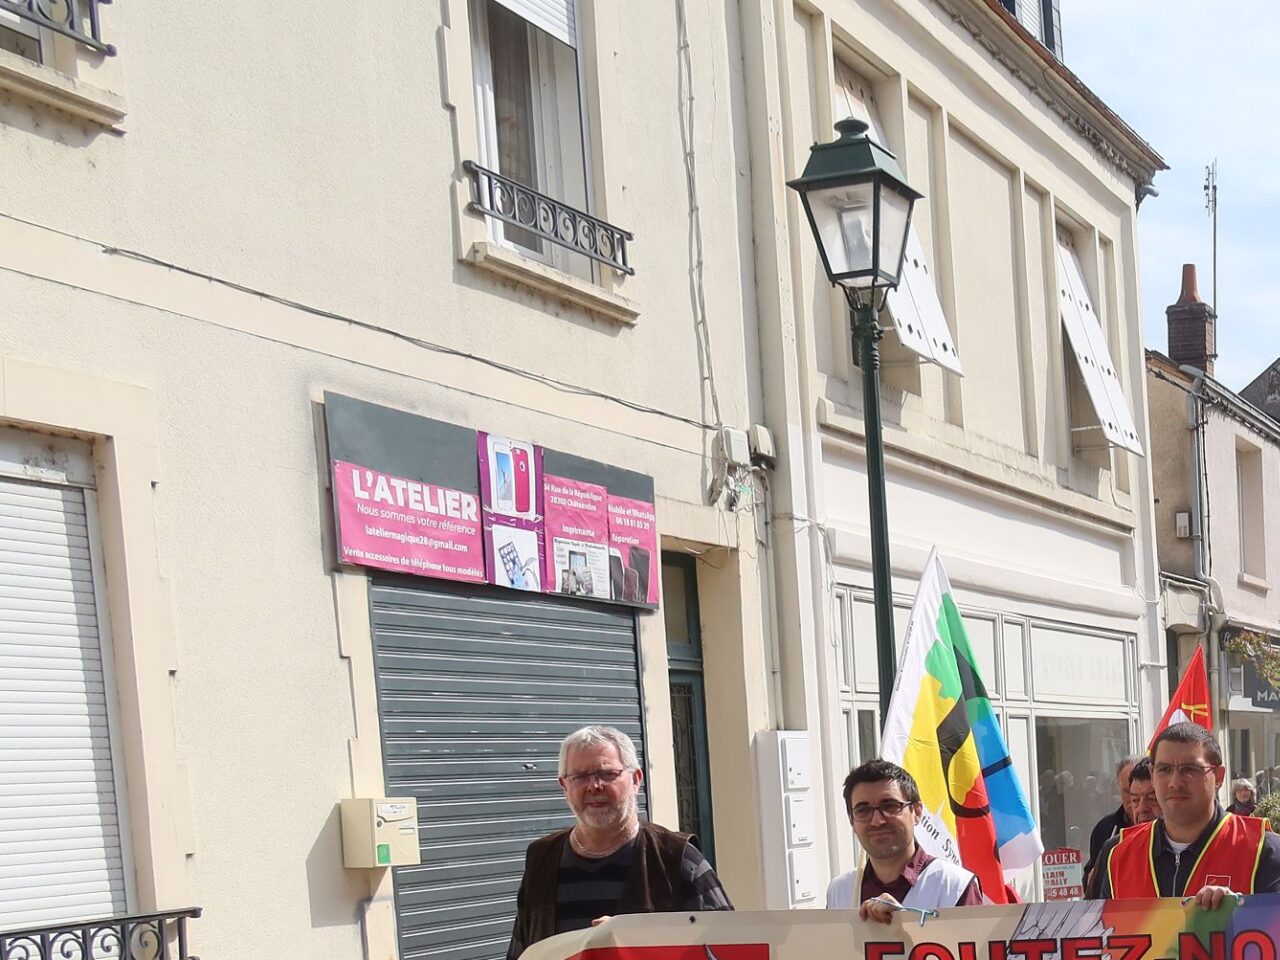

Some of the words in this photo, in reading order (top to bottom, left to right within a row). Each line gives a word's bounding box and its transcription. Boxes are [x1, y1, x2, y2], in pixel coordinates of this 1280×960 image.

[352, 469, 478, 522] L'ATELIER
[357, 503, 378, 517] Nous
[380, 507, 416, 525] sommes
[417, 516, 438, 530] votre
[438, 519, 477, 536] référence
[562, 524, 595, 537] Imprimante
[365, 525, 468, 553] lateliermagique28@gmail.com
[343, 546, 364, 557] Vente
[364, 551, 400, 565] accessoires
[400, 556, 410, 565] de
[411, 557, 445, 571] téléphone
[443, 562, 456, 572] tous
[1043, 852, 1077, 865] OUER
